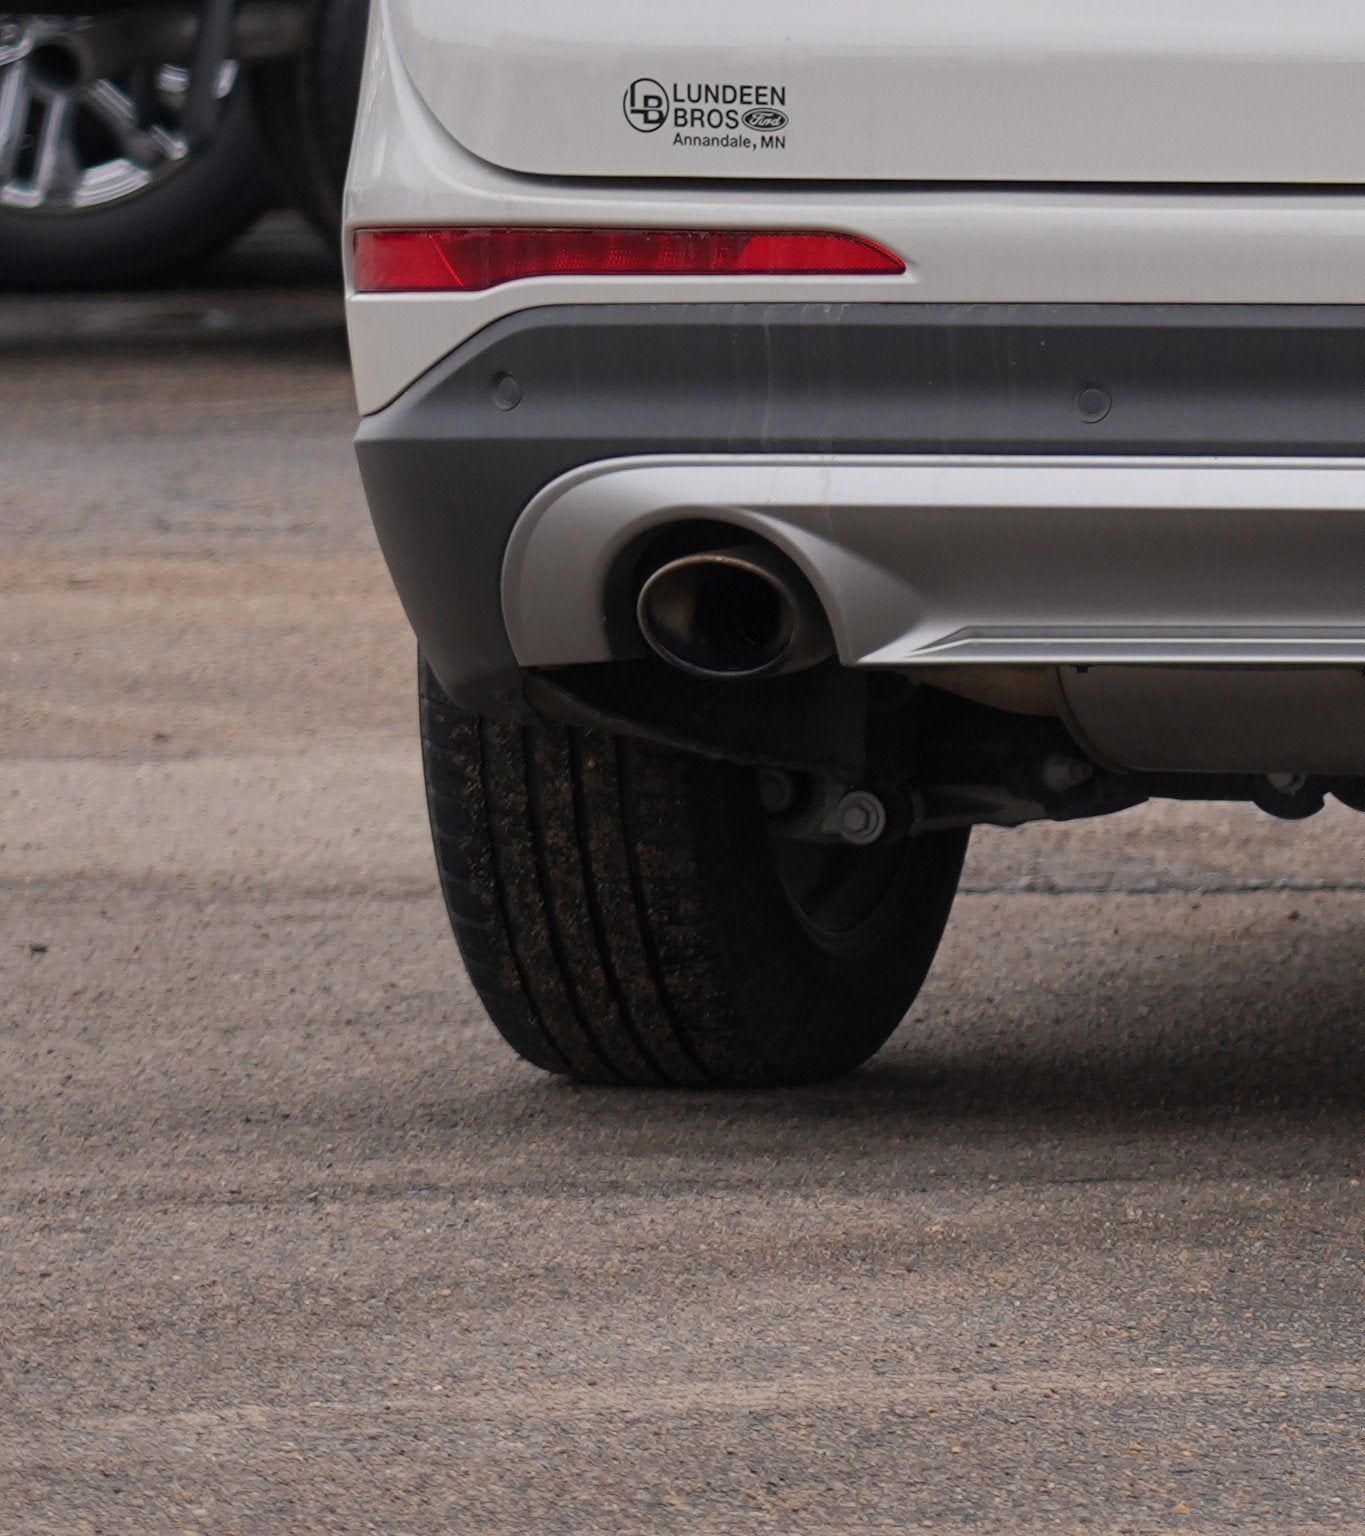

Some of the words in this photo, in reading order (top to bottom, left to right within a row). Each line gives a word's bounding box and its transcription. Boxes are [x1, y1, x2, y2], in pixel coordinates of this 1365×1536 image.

[672, 82, 787, 106] LUNDEEN
[673, 107, 740, 130] BROS
[672, 132, 758, 151] Annandale,
[760, 135, 787, 150] MN
